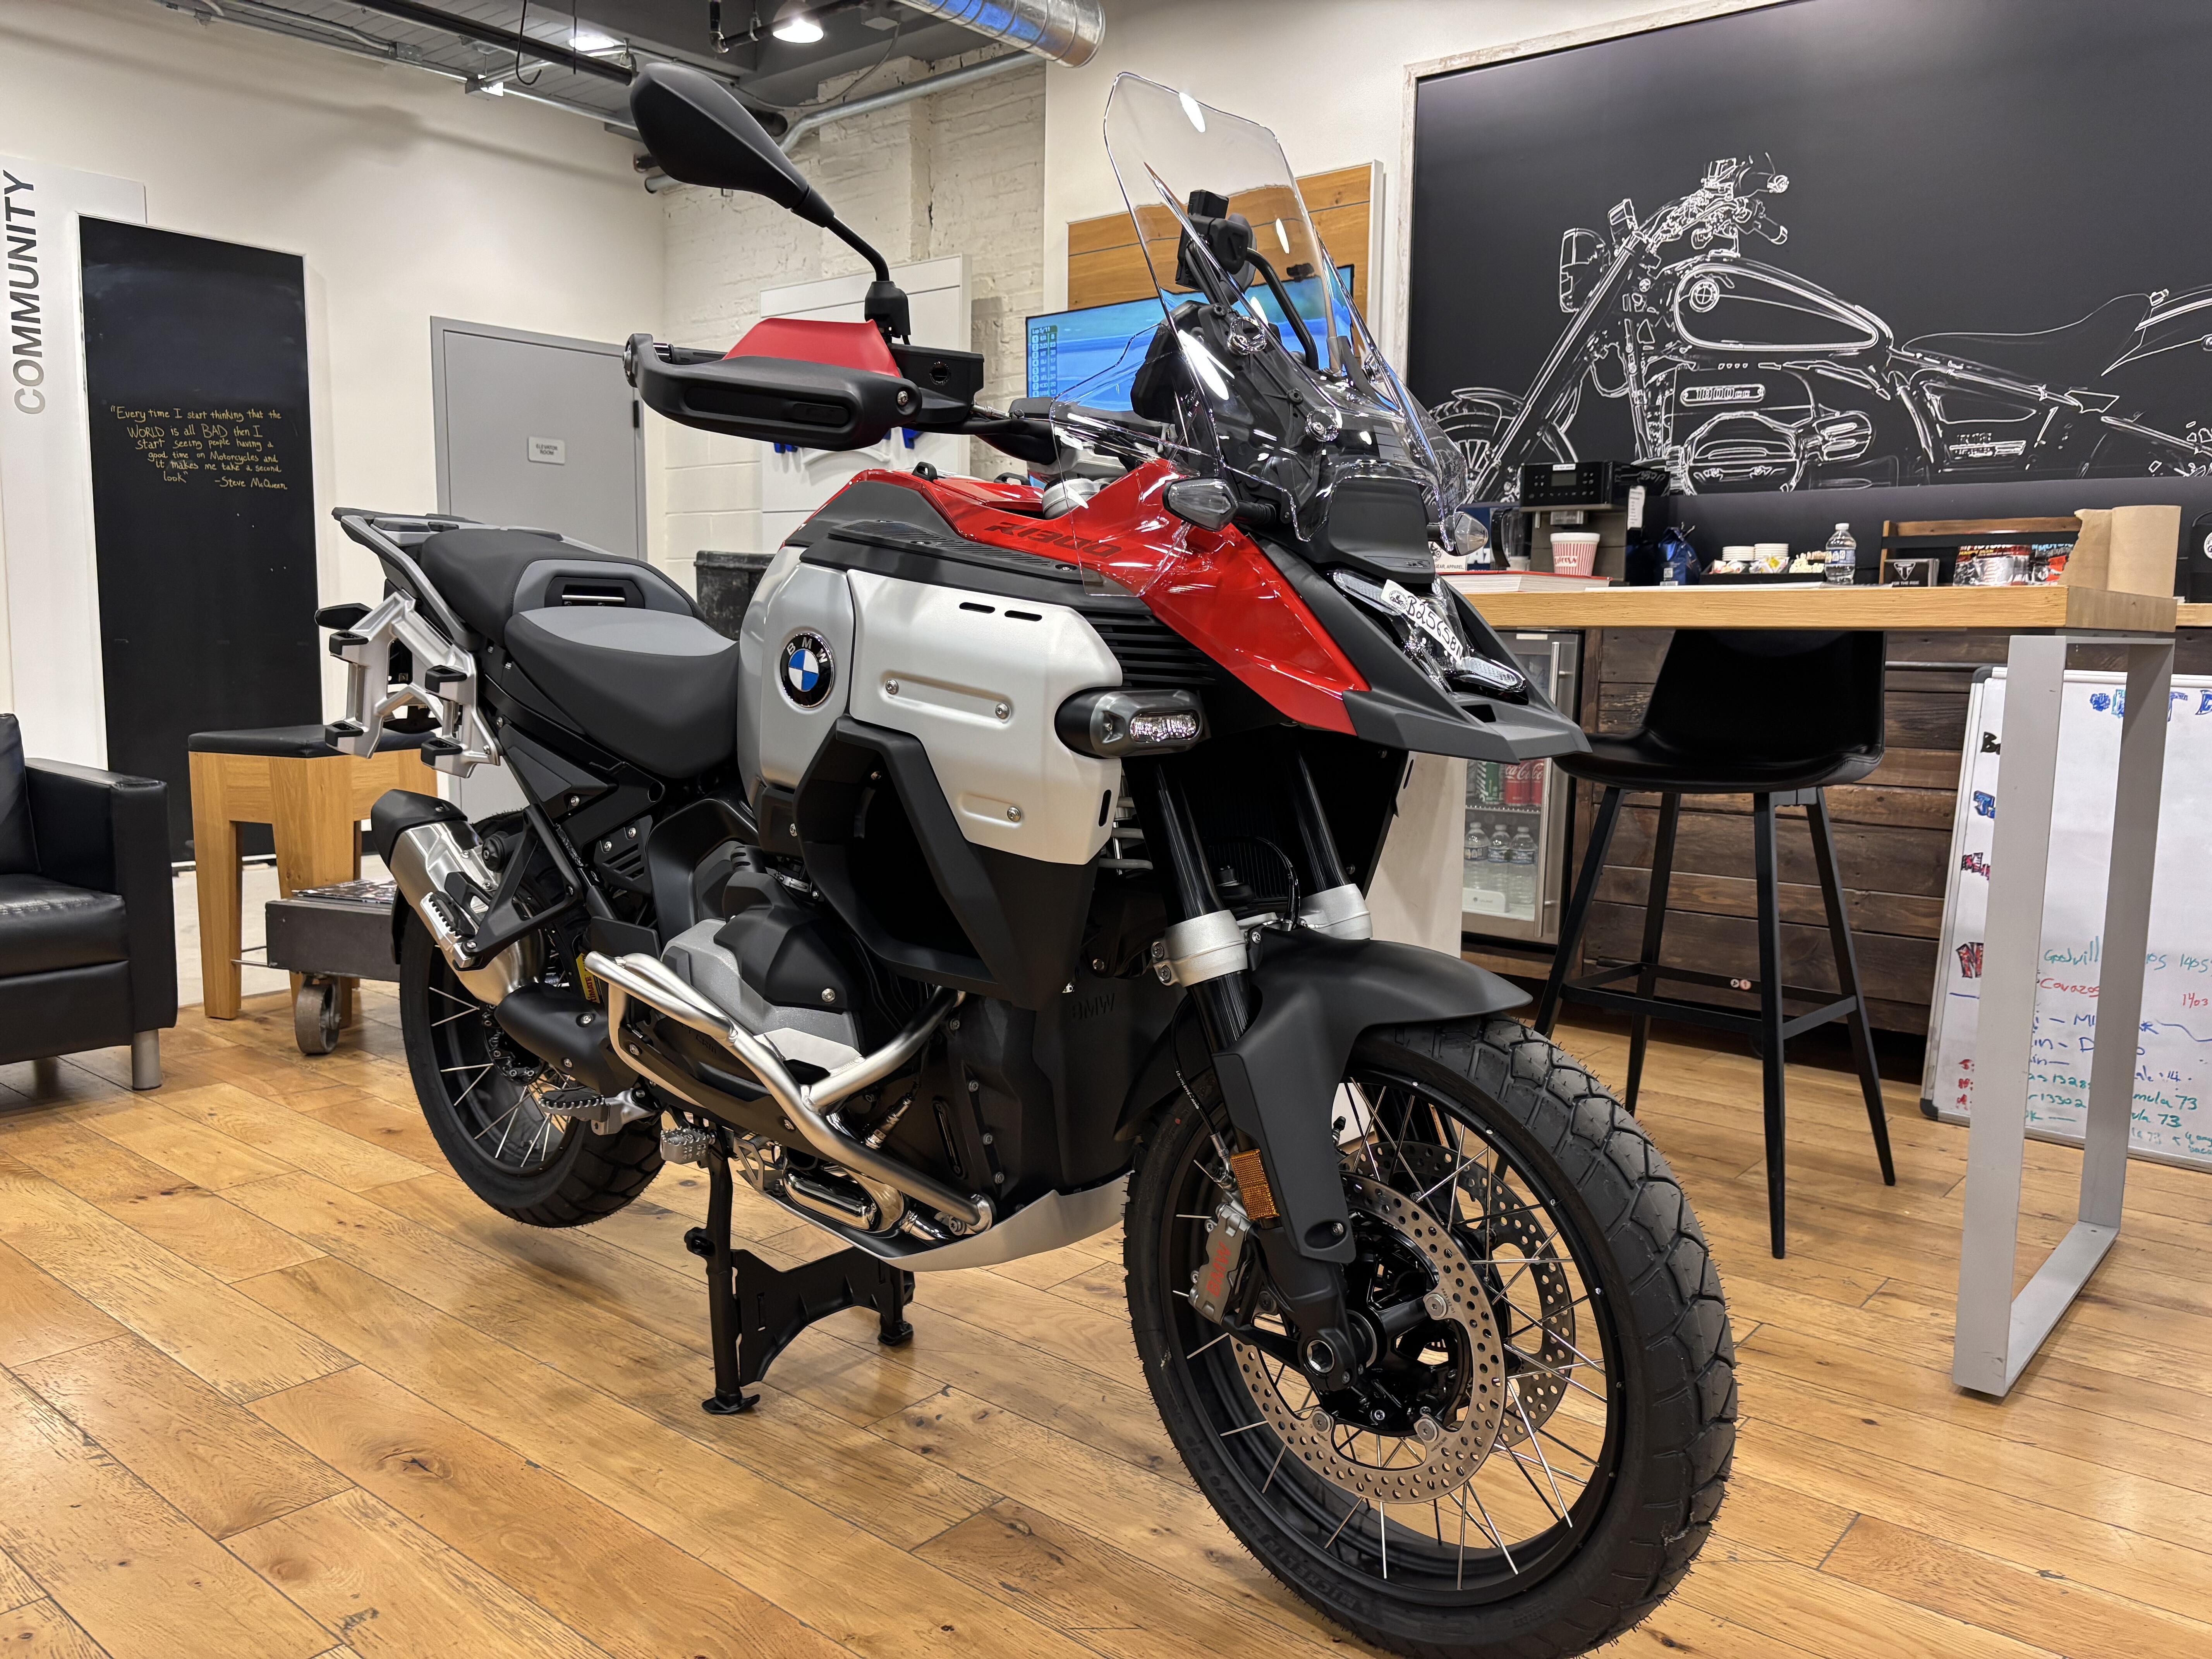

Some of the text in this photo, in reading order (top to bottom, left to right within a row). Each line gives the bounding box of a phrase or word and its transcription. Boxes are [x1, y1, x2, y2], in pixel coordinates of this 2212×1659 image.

[3, 169, 45, 414] COMMUNITY
[148, 409, 170, 418] time
[173, 408, 182, 419] I
[187, 410, 207, 419] start
[210, 409, 244, 422] thinking
[246, 409, 263, 419] that
[268, 409, 282, 419] the
[127, 423, 263, 438] WORLD is all BAD then I
[208, 438, 230, 449] people
[236, 438, 262, 452] having
[147, 451, 168, 462] good
[210, 450, 259, 465] Motorcycles
[263, 454, 278, 463] and
[156, 459, 165, 468] it
[170, 459, 199, 469] makes
[222, 462, 240, 471] take
[255, 464, 282, 472] second
[787, 637, 828, 663] BMW
[1206, 1242, 1231, 1298] BMW
